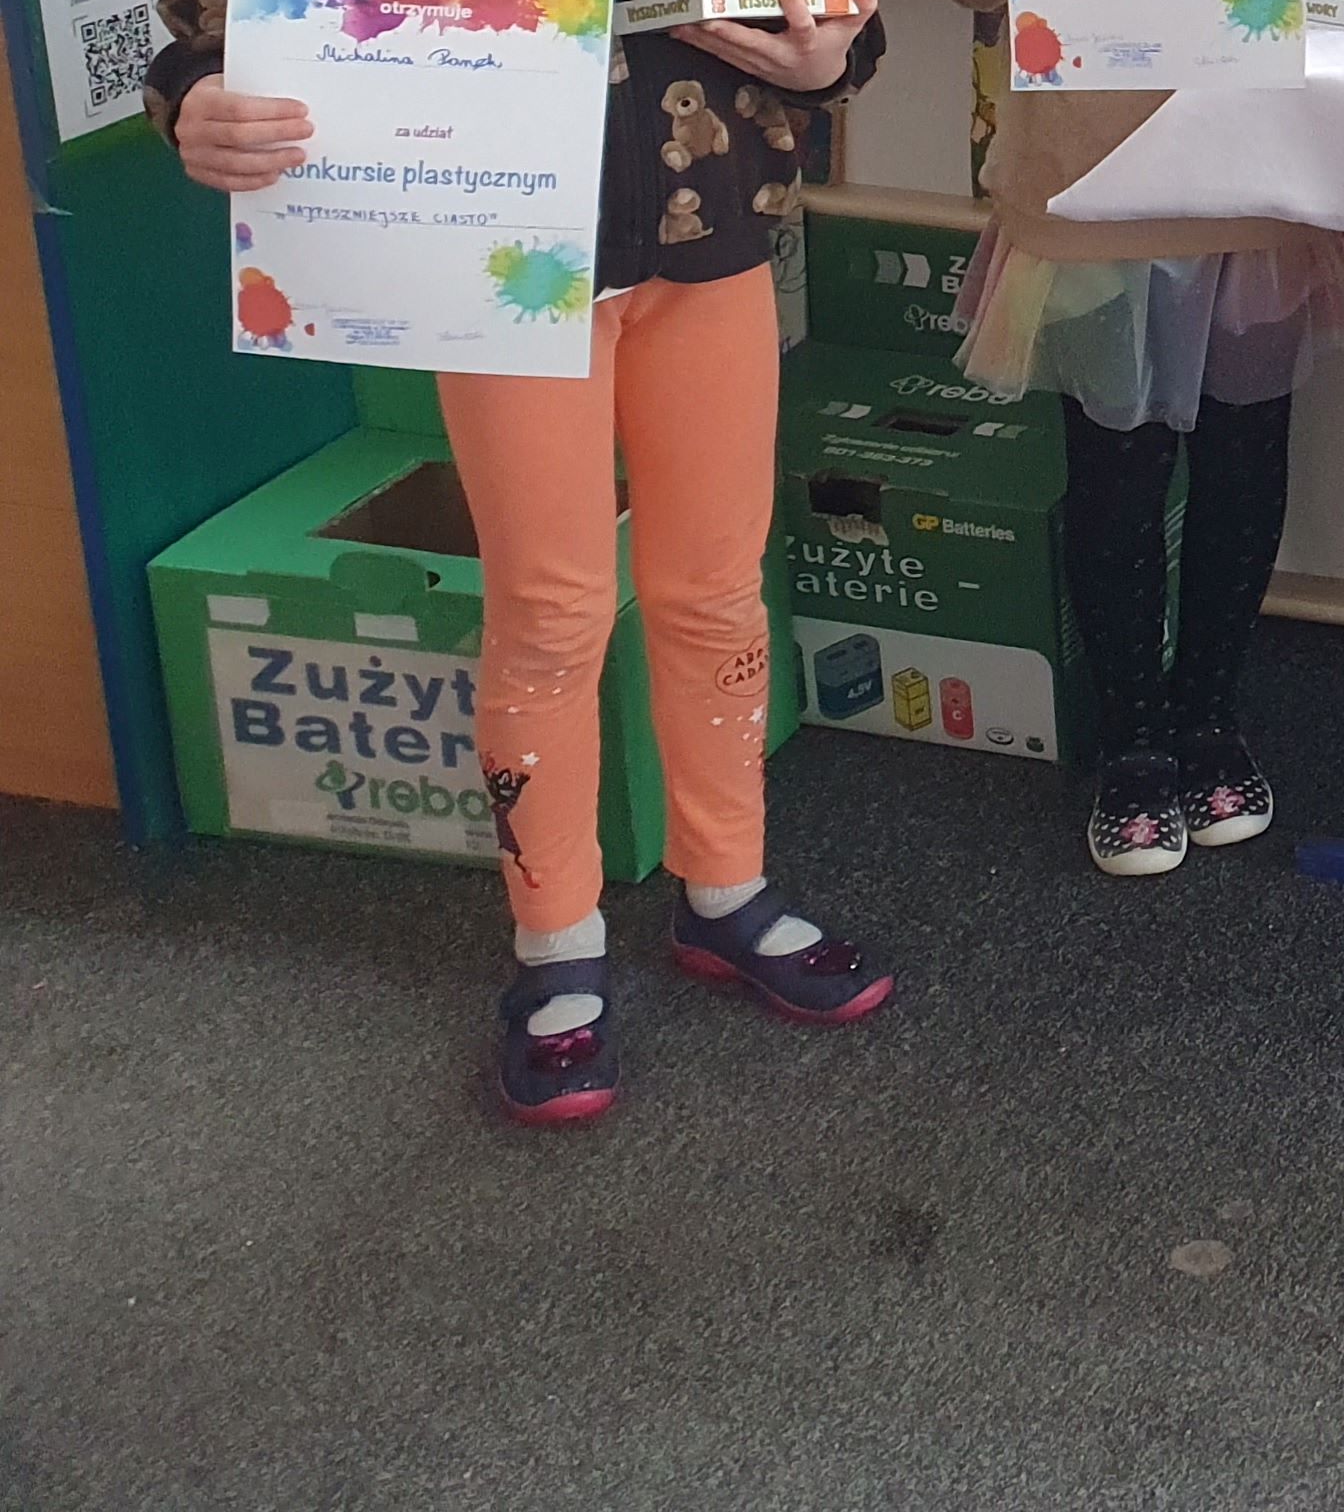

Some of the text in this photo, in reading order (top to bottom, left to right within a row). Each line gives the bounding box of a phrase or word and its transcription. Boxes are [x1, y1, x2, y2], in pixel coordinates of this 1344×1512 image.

[379, 0, 474, 22] otrzymuje
[394, 124, 455, 140] za udział
[402, 159, 558, 195] plastycznym
[911, 512, 1016, 542] GP Batteries
[795, 571, 939, 611] aterie
[247, 645, 476, 721] Zużyt
[231, 697, 475, 769] Bater
